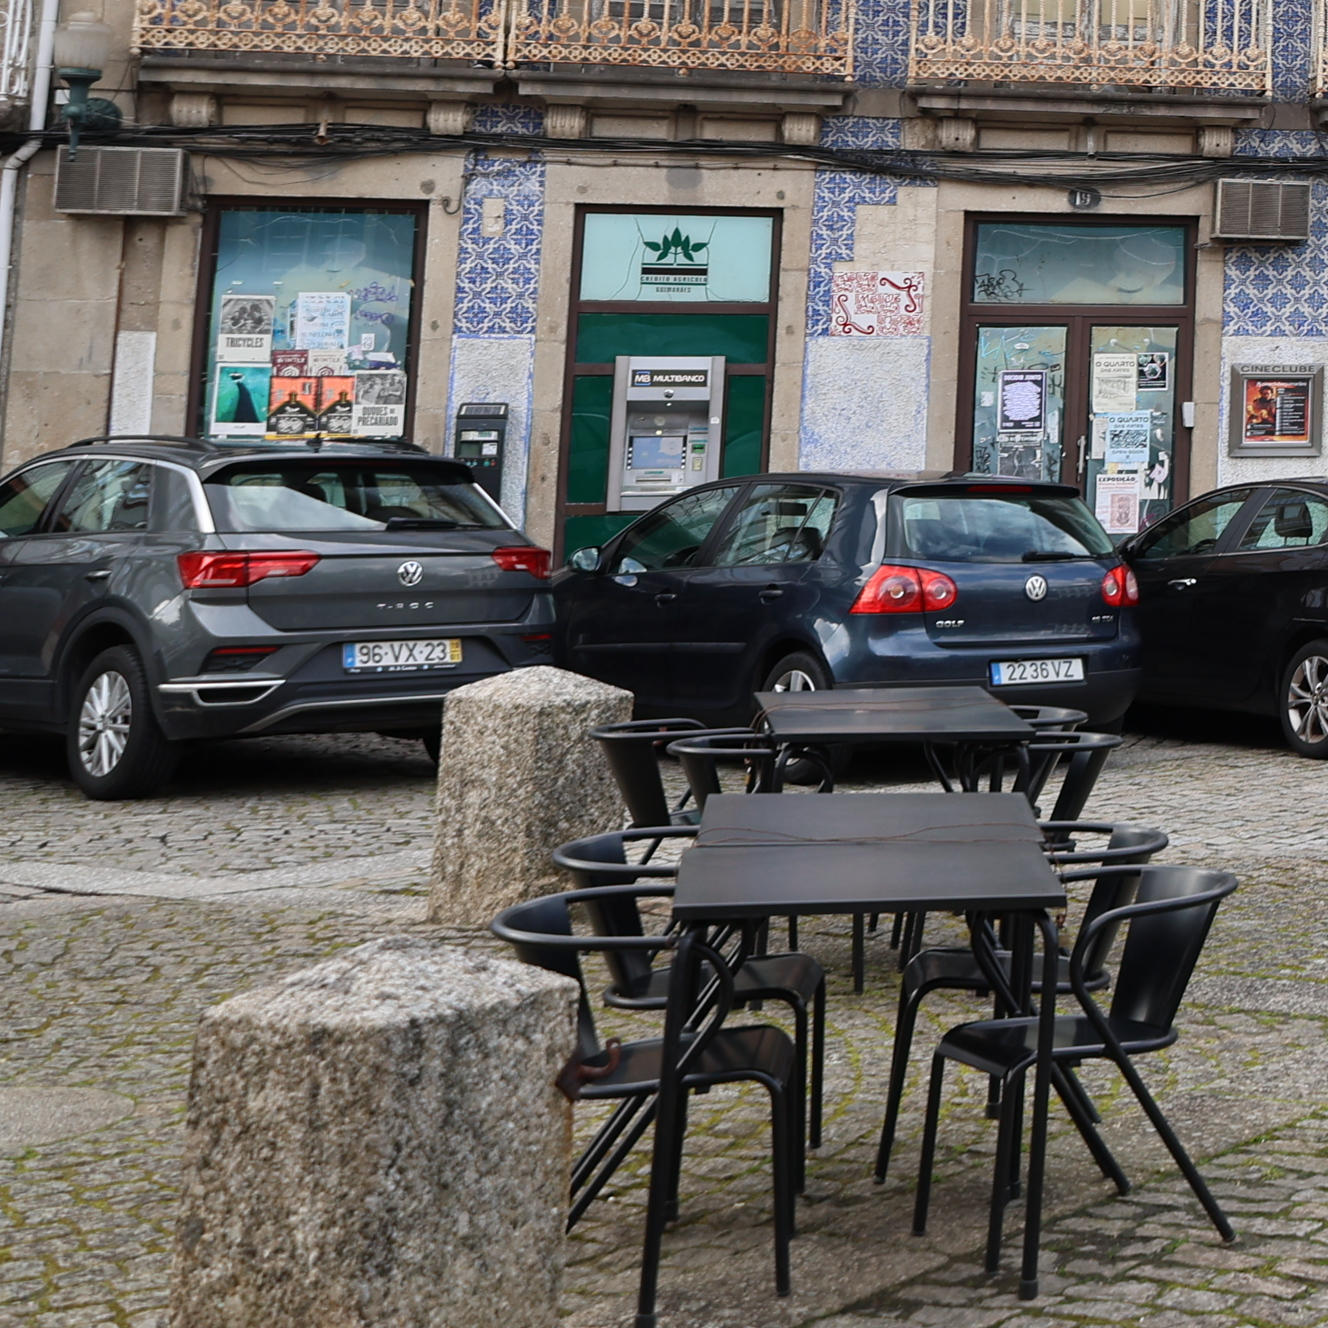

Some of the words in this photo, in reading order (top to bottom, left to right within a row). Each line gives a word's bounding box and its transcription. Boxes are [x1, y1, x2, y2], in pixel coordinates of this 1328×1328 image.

[1075, 191, 1091, 206] 19
[225, 337, 265, 348] TRICYCLES
[1240, 365, 1315, 373] CINECLUBE
[634, 374, 651, 383] MB
[653, 374, 705, 383] MULTIBANCO
[935, 620, 965, 628] GOLF
